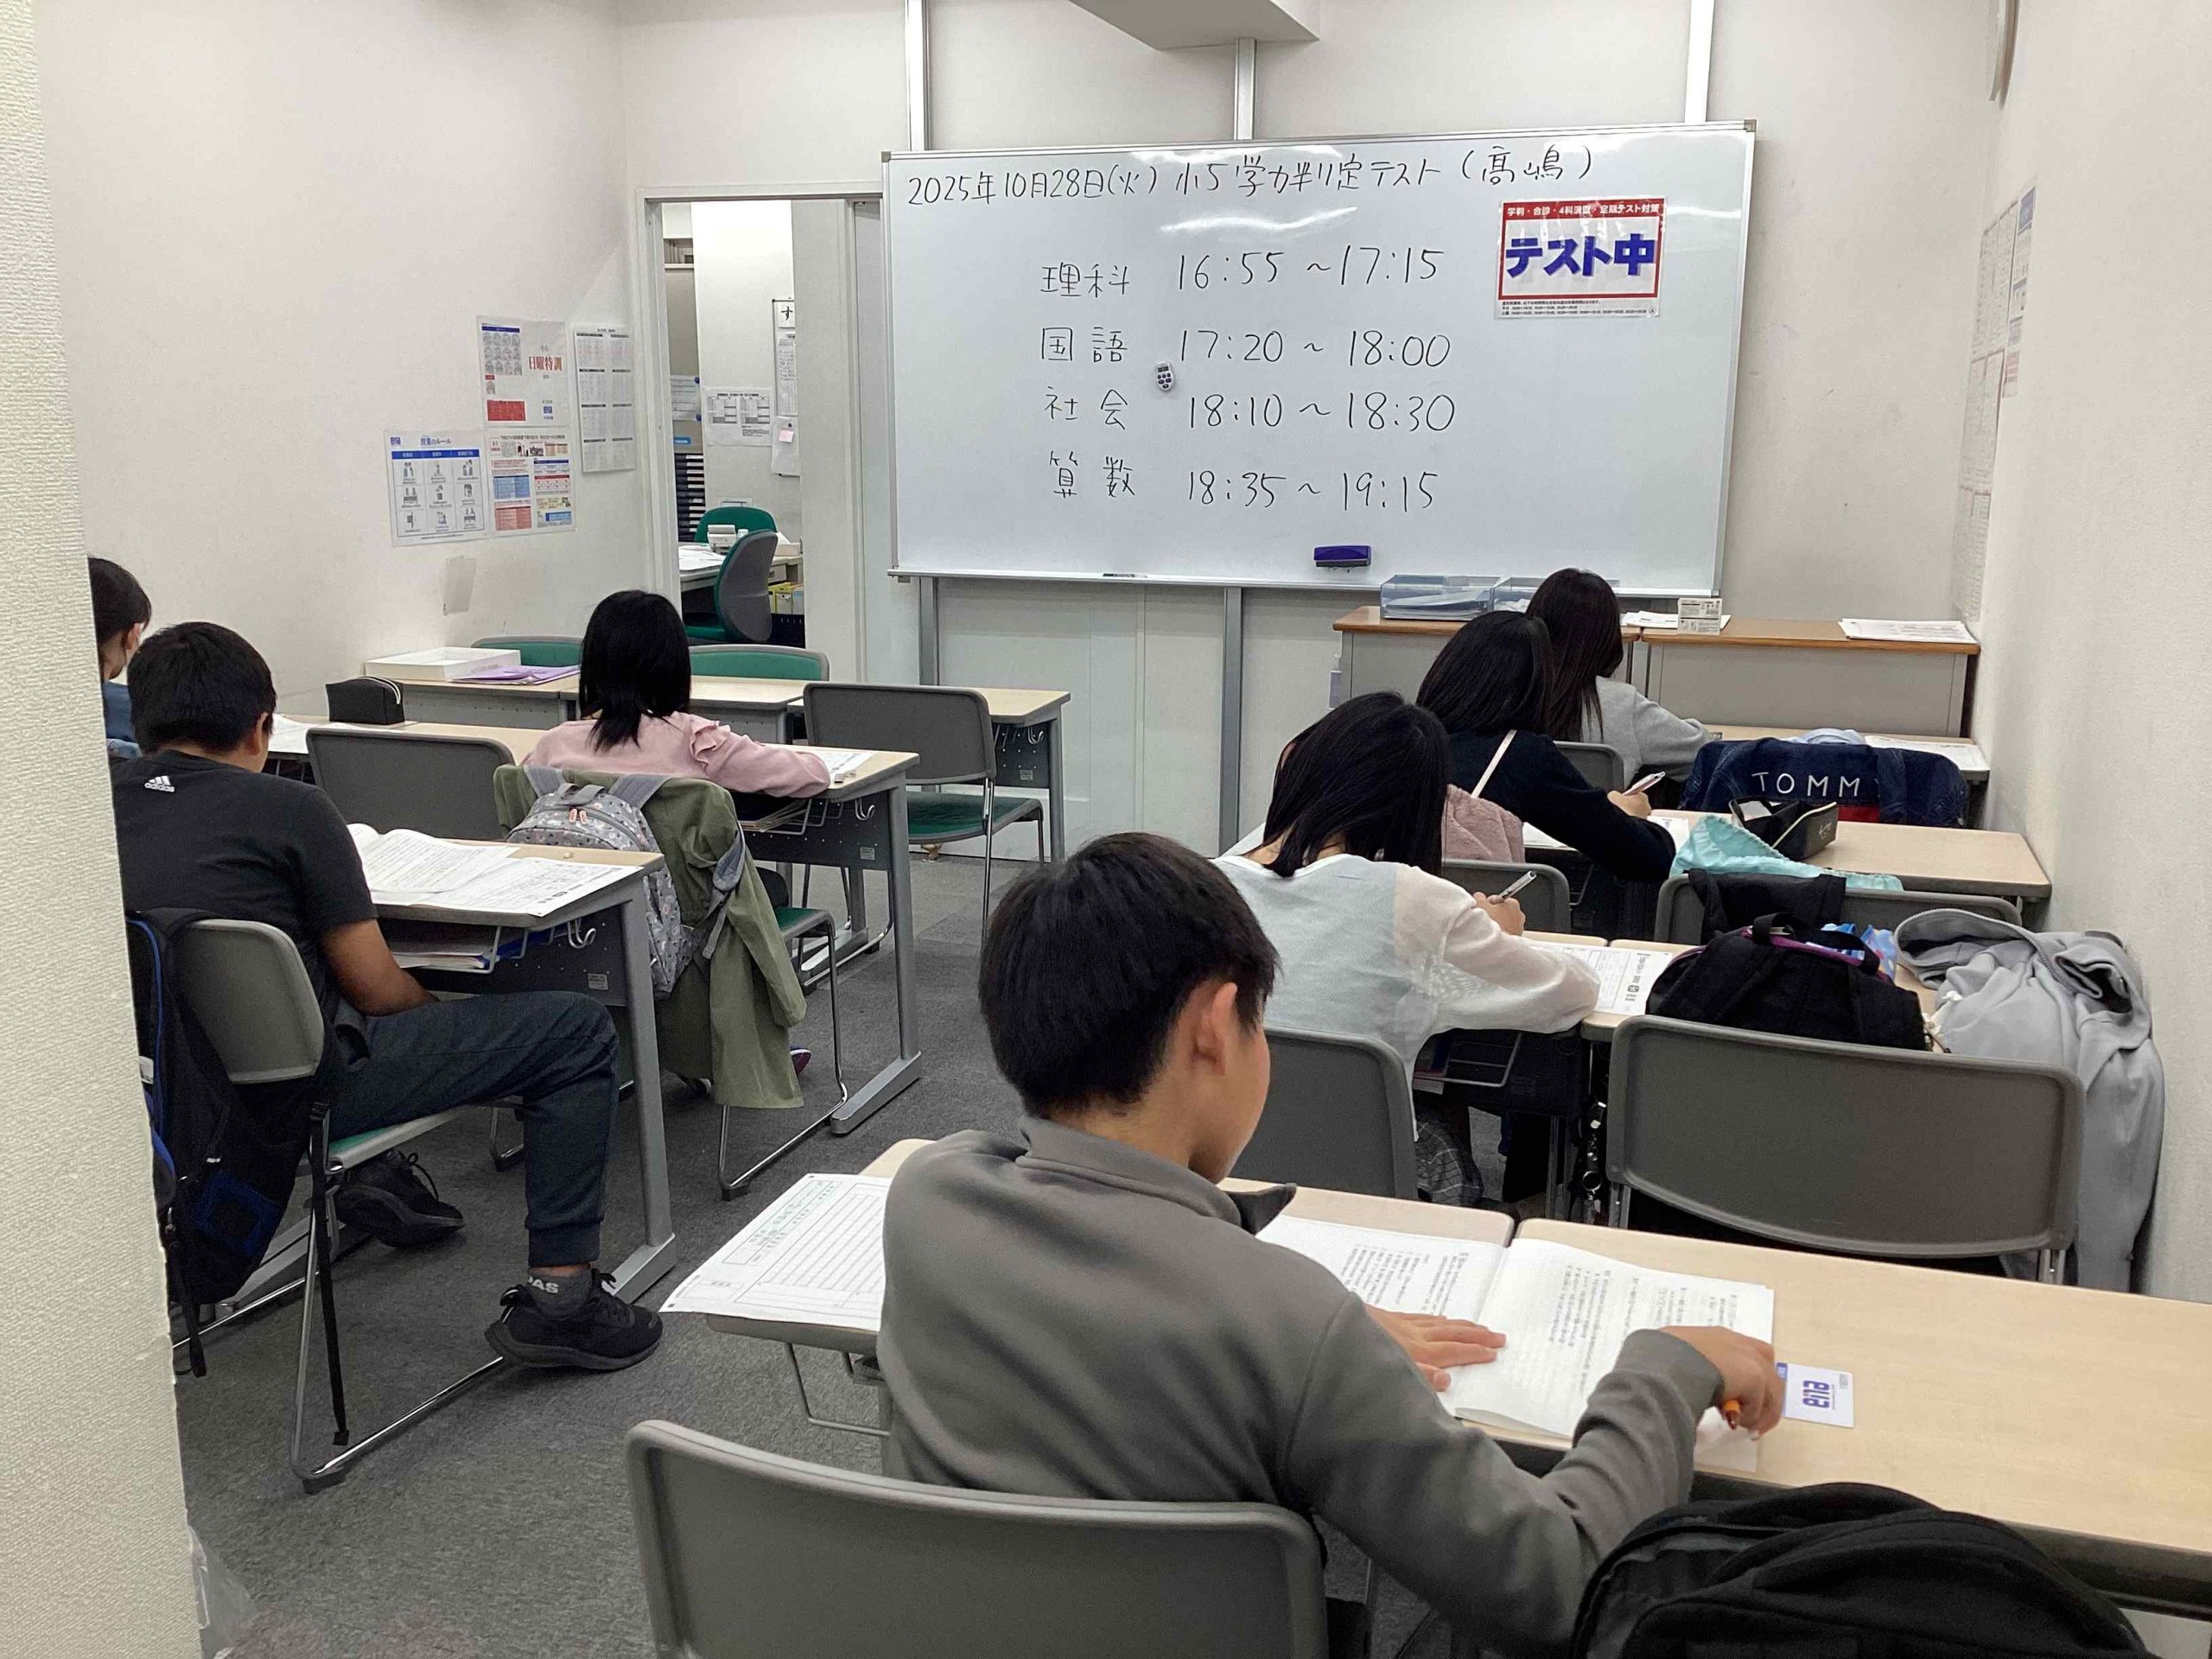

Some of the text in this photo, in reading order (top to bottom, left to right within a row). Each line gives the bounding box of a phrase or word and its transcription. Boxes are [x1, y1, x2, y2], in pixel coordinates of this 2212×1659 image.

[907, 163, 1158, 206] 2025年10月28日(火)
[1039, 261, 1130, 299] 理科
[1178, 251, 1285, 290] 16:55
[1340, 245, 1445, 286] 17:15
[1505, 232, 1656, 277] テスト中
[1041, 326, 1128, 363] 国語
[1180, 329, 1283, 363] 17:20
[1349, 329, 1451, 367] 18:00
[1043, 385, 1128, 431] 社会
[1189, 393, 1283, 429] 18:10
[1347, 391, 1456, 433] 18:30
[1048, 450, 1135, 499] 算数
[1188, 470, 1287, 508] 18:35
[1342, 471, 1439, 513] 19:15
[144, 782, 175, 792] adidas
[1751, 772, 1879, 798] TOMM
